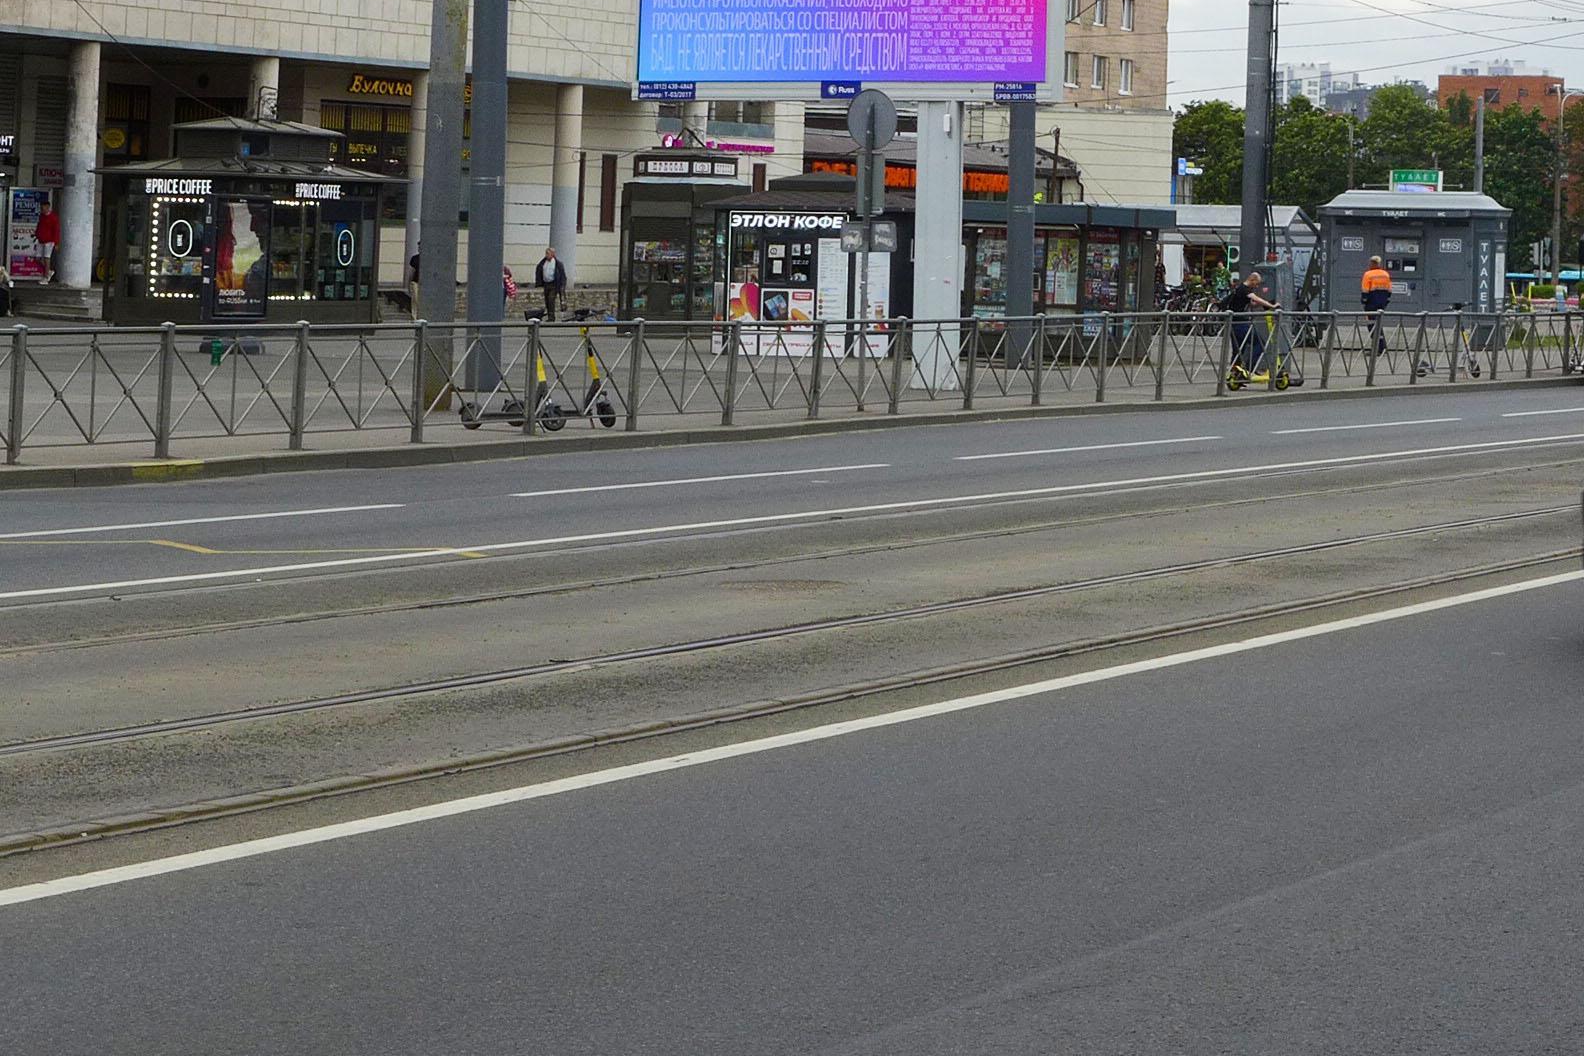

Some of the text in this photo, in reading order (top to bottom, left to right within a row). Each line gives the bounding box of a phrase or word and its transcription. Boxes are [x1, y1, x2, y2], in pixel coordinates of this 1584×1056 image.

[652, 11, 908, 34] ПРОКОНСУЛЬТИРОВАТЬСЯ СО СПЕЦИАЛИСТОМ
[677, 33, 692, 71] НЕ
[693, 33, 746, 71] ЯВЛЯЕТСЯ
[746, 33, 841, 71] ЛЕКАРСТВЕННЫМ
[843, 32, 907, 75] СРЕДСТВОМ
[350, 75, 413, 96] Булочна
[152, 179, 178, 194] PRICE
[179, 179, 212, 194] COFFEE
[300, 183, 318, 198] PRICE
[319, 184, 341, 200] COFFEE
[731, 215, 844, 229] ЭТЛОН КОФЕ
[1480, 242, 1489, 313] ТУАЛЕТ
